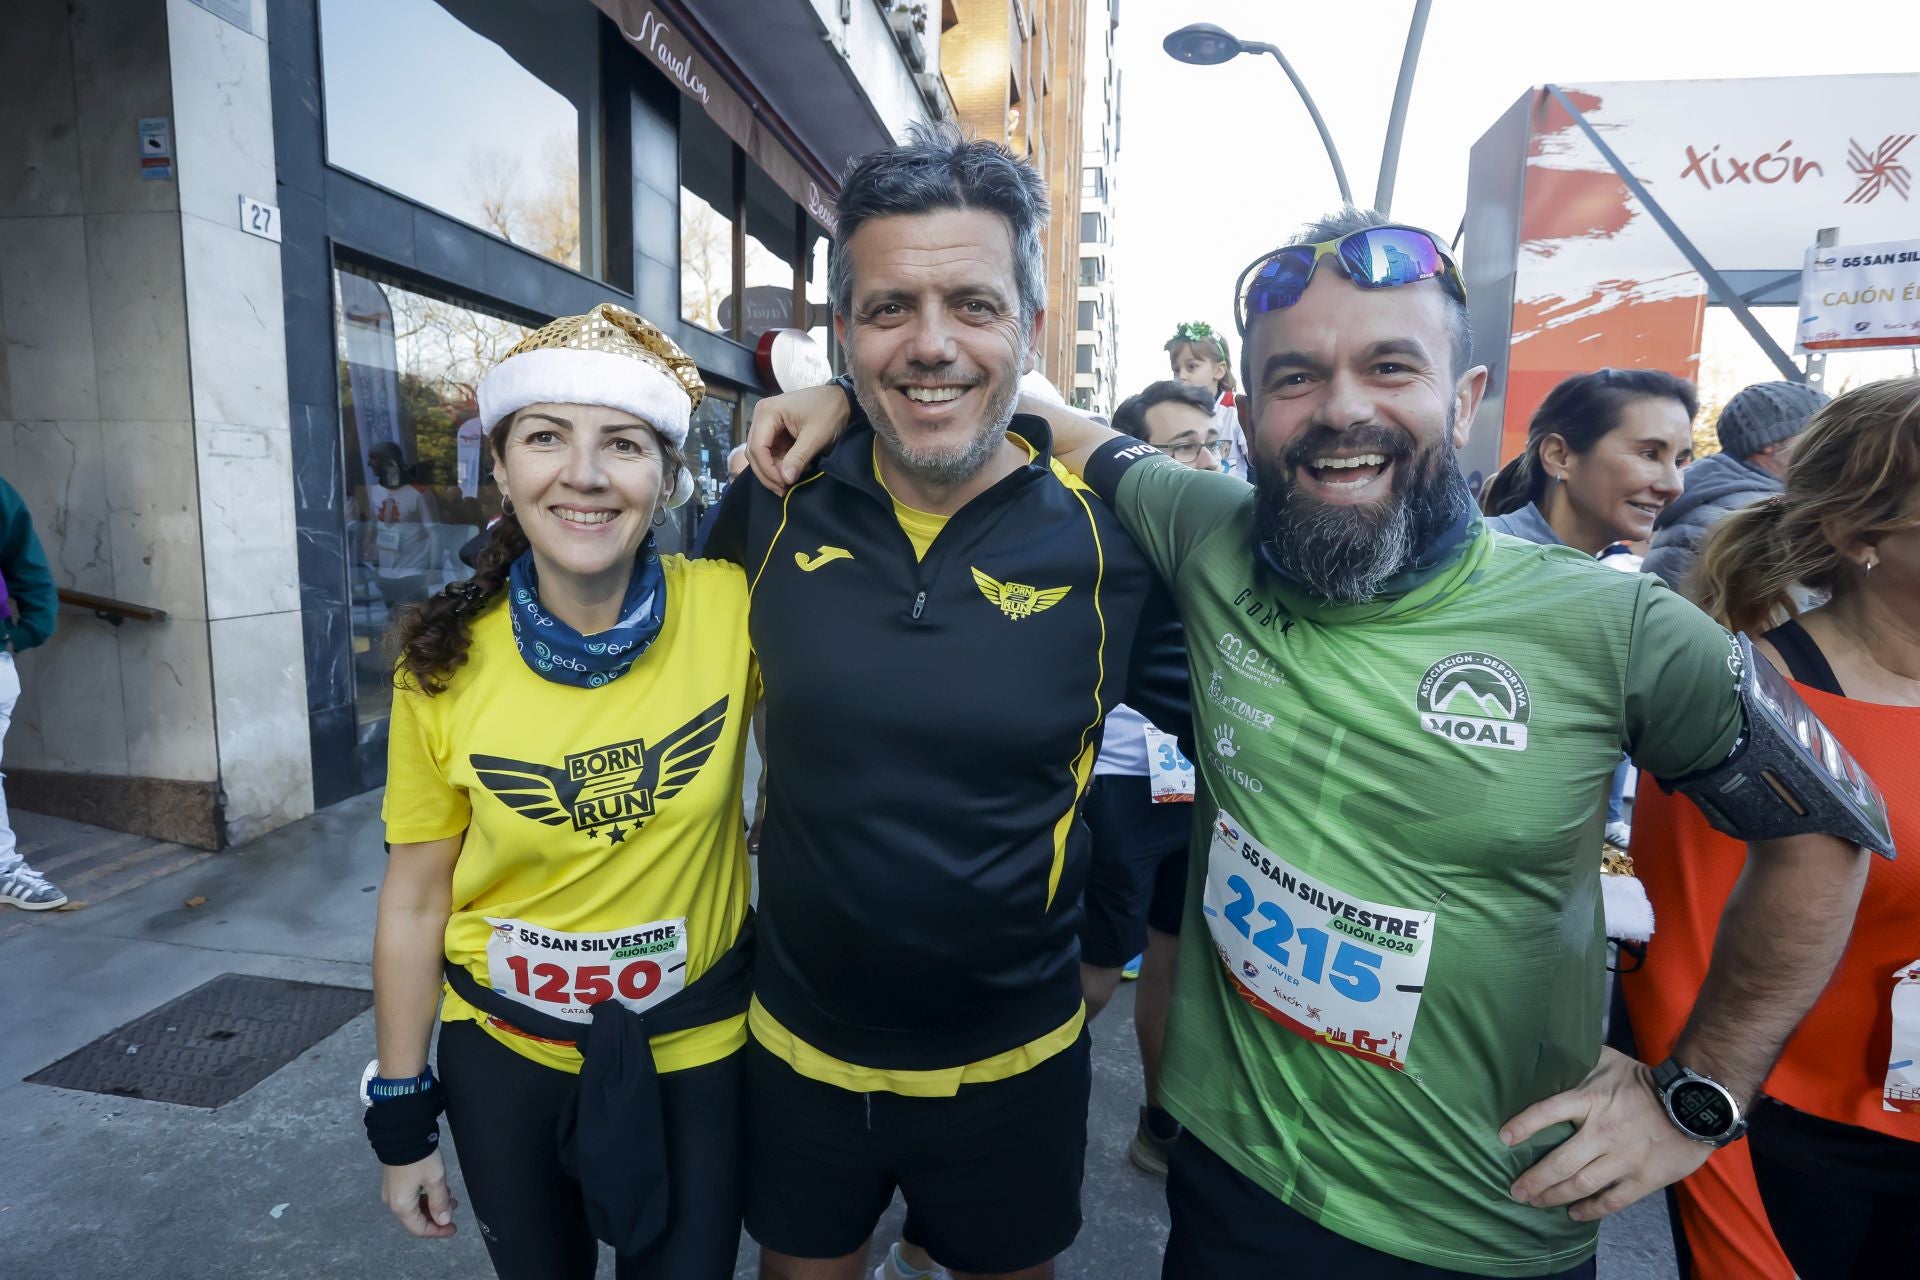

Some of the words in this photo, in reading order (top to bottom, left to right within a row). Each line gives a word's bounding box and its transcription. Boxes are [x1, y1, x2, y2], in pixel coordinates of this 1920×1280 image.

[624, 10, 710, 104] Navalon
[1680, 139, 1824, 190] Xixón
[251, 204, 271, 233] 27
[1841, 256, 1862, 268] 55
[1862, 253, 1896, 266] SAN
[1823, 285, 1895, 307] CAJÓN
[1003, 600, 1030, 613] RUN
[1005, 584, 1033, 597] BORN
[1421, 655, 1473, 698] ASOCIACIÓN
[1482, 657, 1527, 708] DEPORTIVA
[1429, 718, 1515, 746] MOAL
[571, 744, 643, 779] BORN
[576, 789, 649, 826] RUN
[1241, 842, 1261, 868] 55
[1260, 857, 1297, 894] SAN
[1297, 882, 1420, 940] SILVESTRE
[519, 928, 539, 945] 55
[541, 937, 578, 952] SAN
[580, 925, 676, 952] SILVESTRE
[615, 945, 648, 958] GIJÓN
[649, 940, 675, 953] 2024
[1224, 874, 1384, 1003] 2215
[1333, 919, 1375, 943] GIJÓN
[1377, 935, 1414, 954] 2024
[505, 955, 662, 1006] 1250
[1266, 963, 1300, 987] JAVIER
